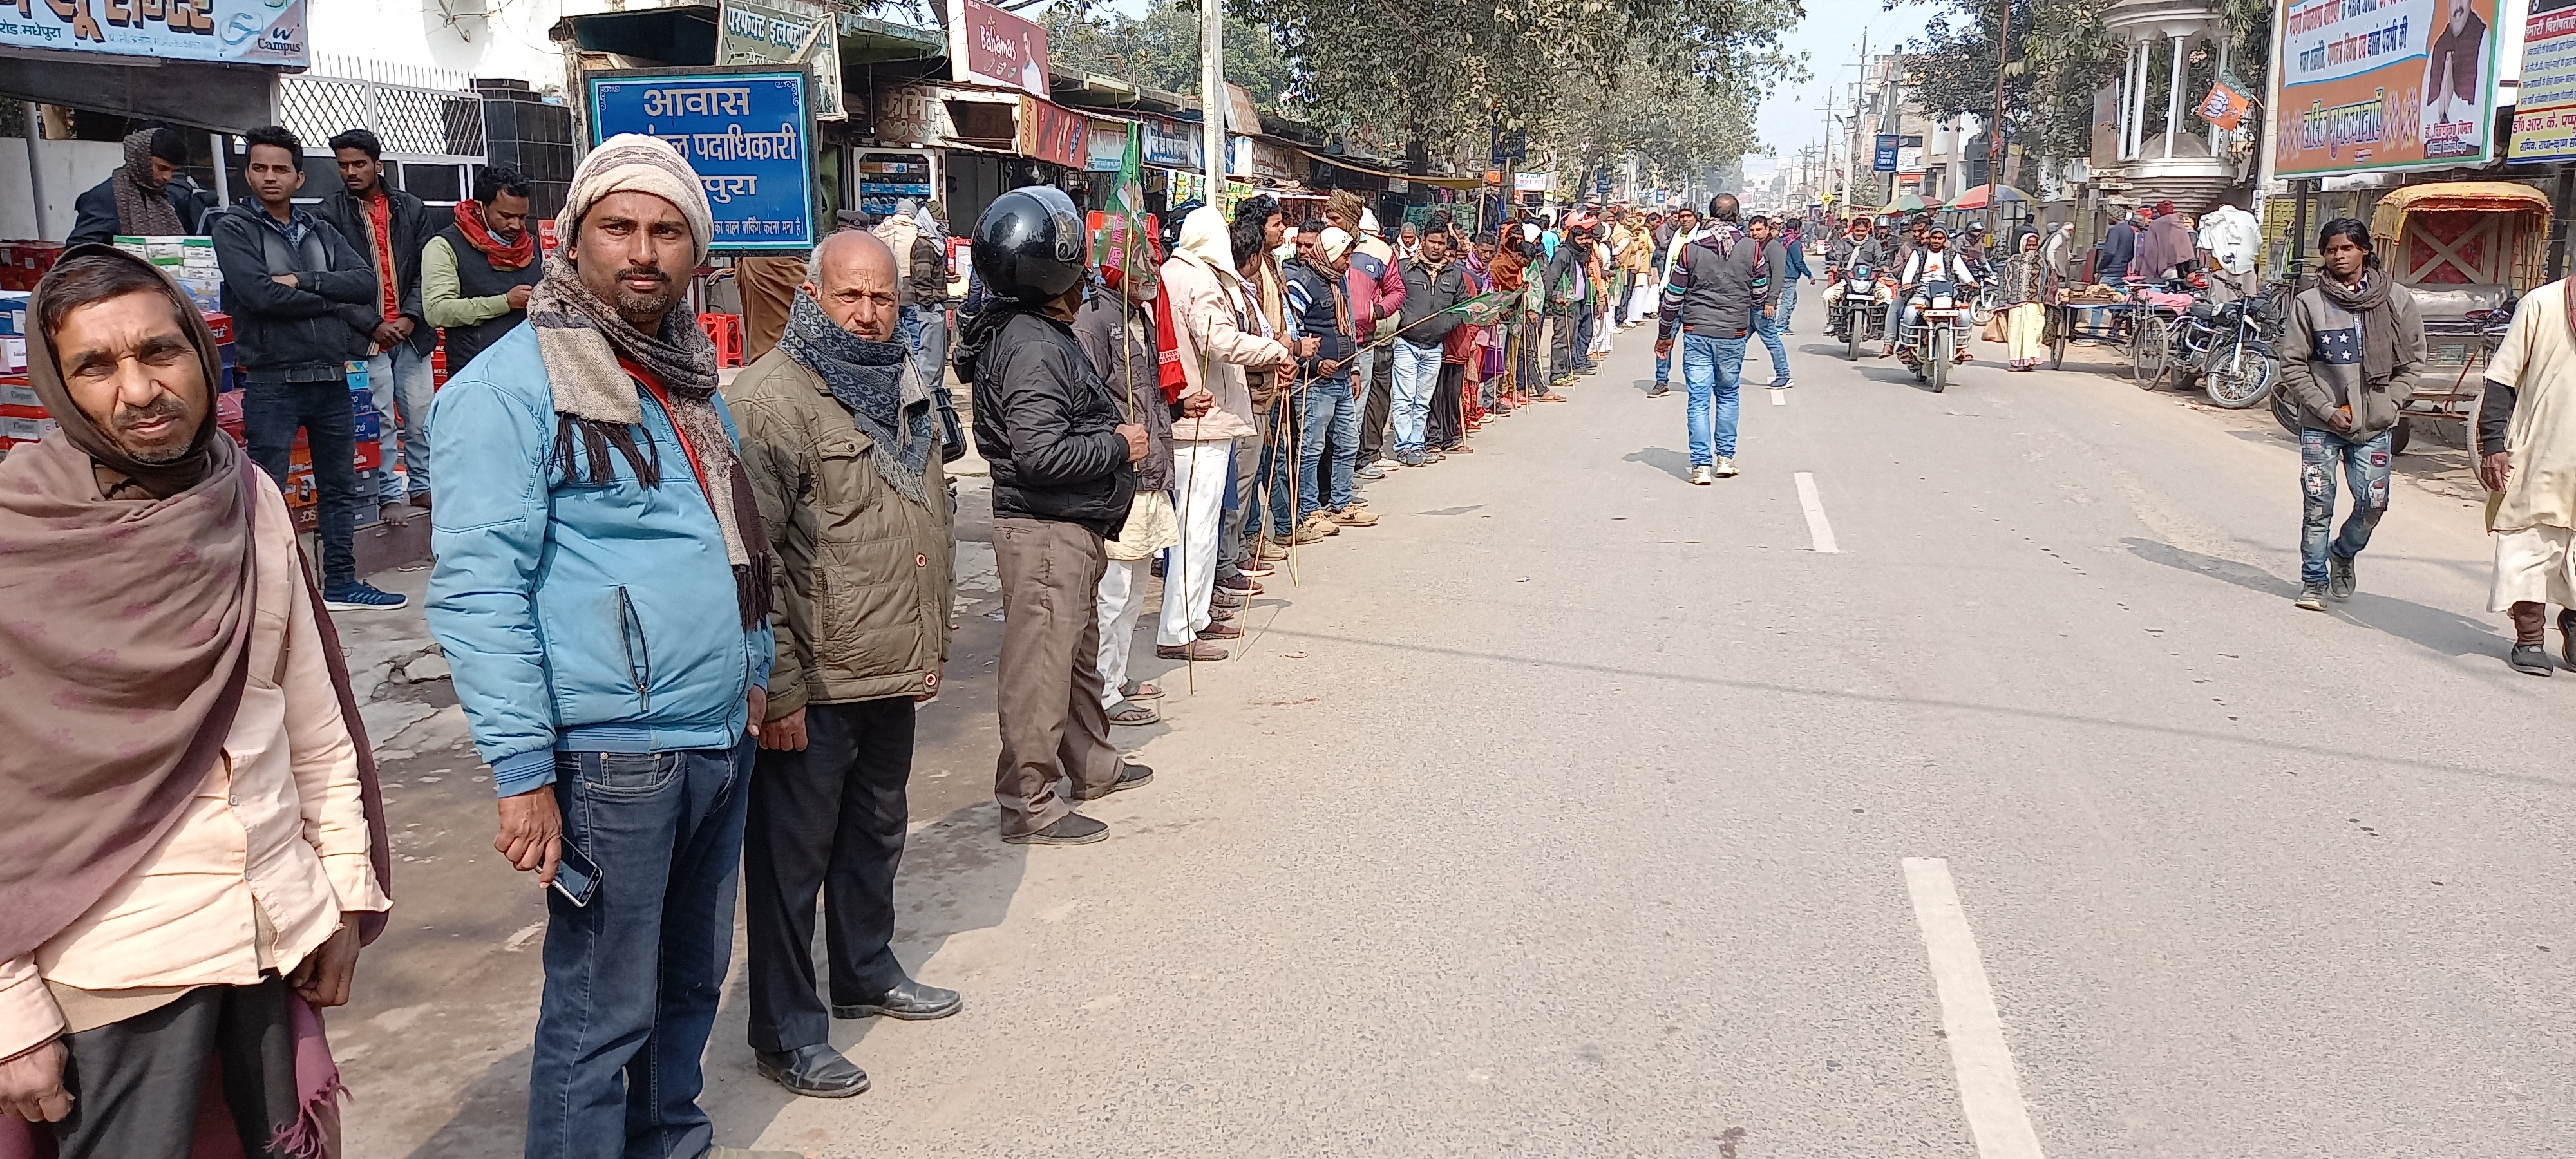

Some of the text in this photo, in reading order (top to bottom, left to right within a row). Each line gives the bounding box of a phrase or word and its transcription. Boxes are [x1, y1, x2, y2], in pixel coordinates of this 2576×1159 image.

[726, 4, 766, 42] परफेक्ट
[2399, 15, 2409, 50] की
[258, 37, 301, 56] Campus
[980, 24, 1017, 61] Bahamas
[643, 87, 750, 117] आवास
[692, 122, 797, 161] पदाधिकारी
[2303, 99, 2328, 149] हार्दिक
[724, 221, 740, 236] वाहन
[762, 221, 780, 235] करना
[781, 221, 794, 235] मना
